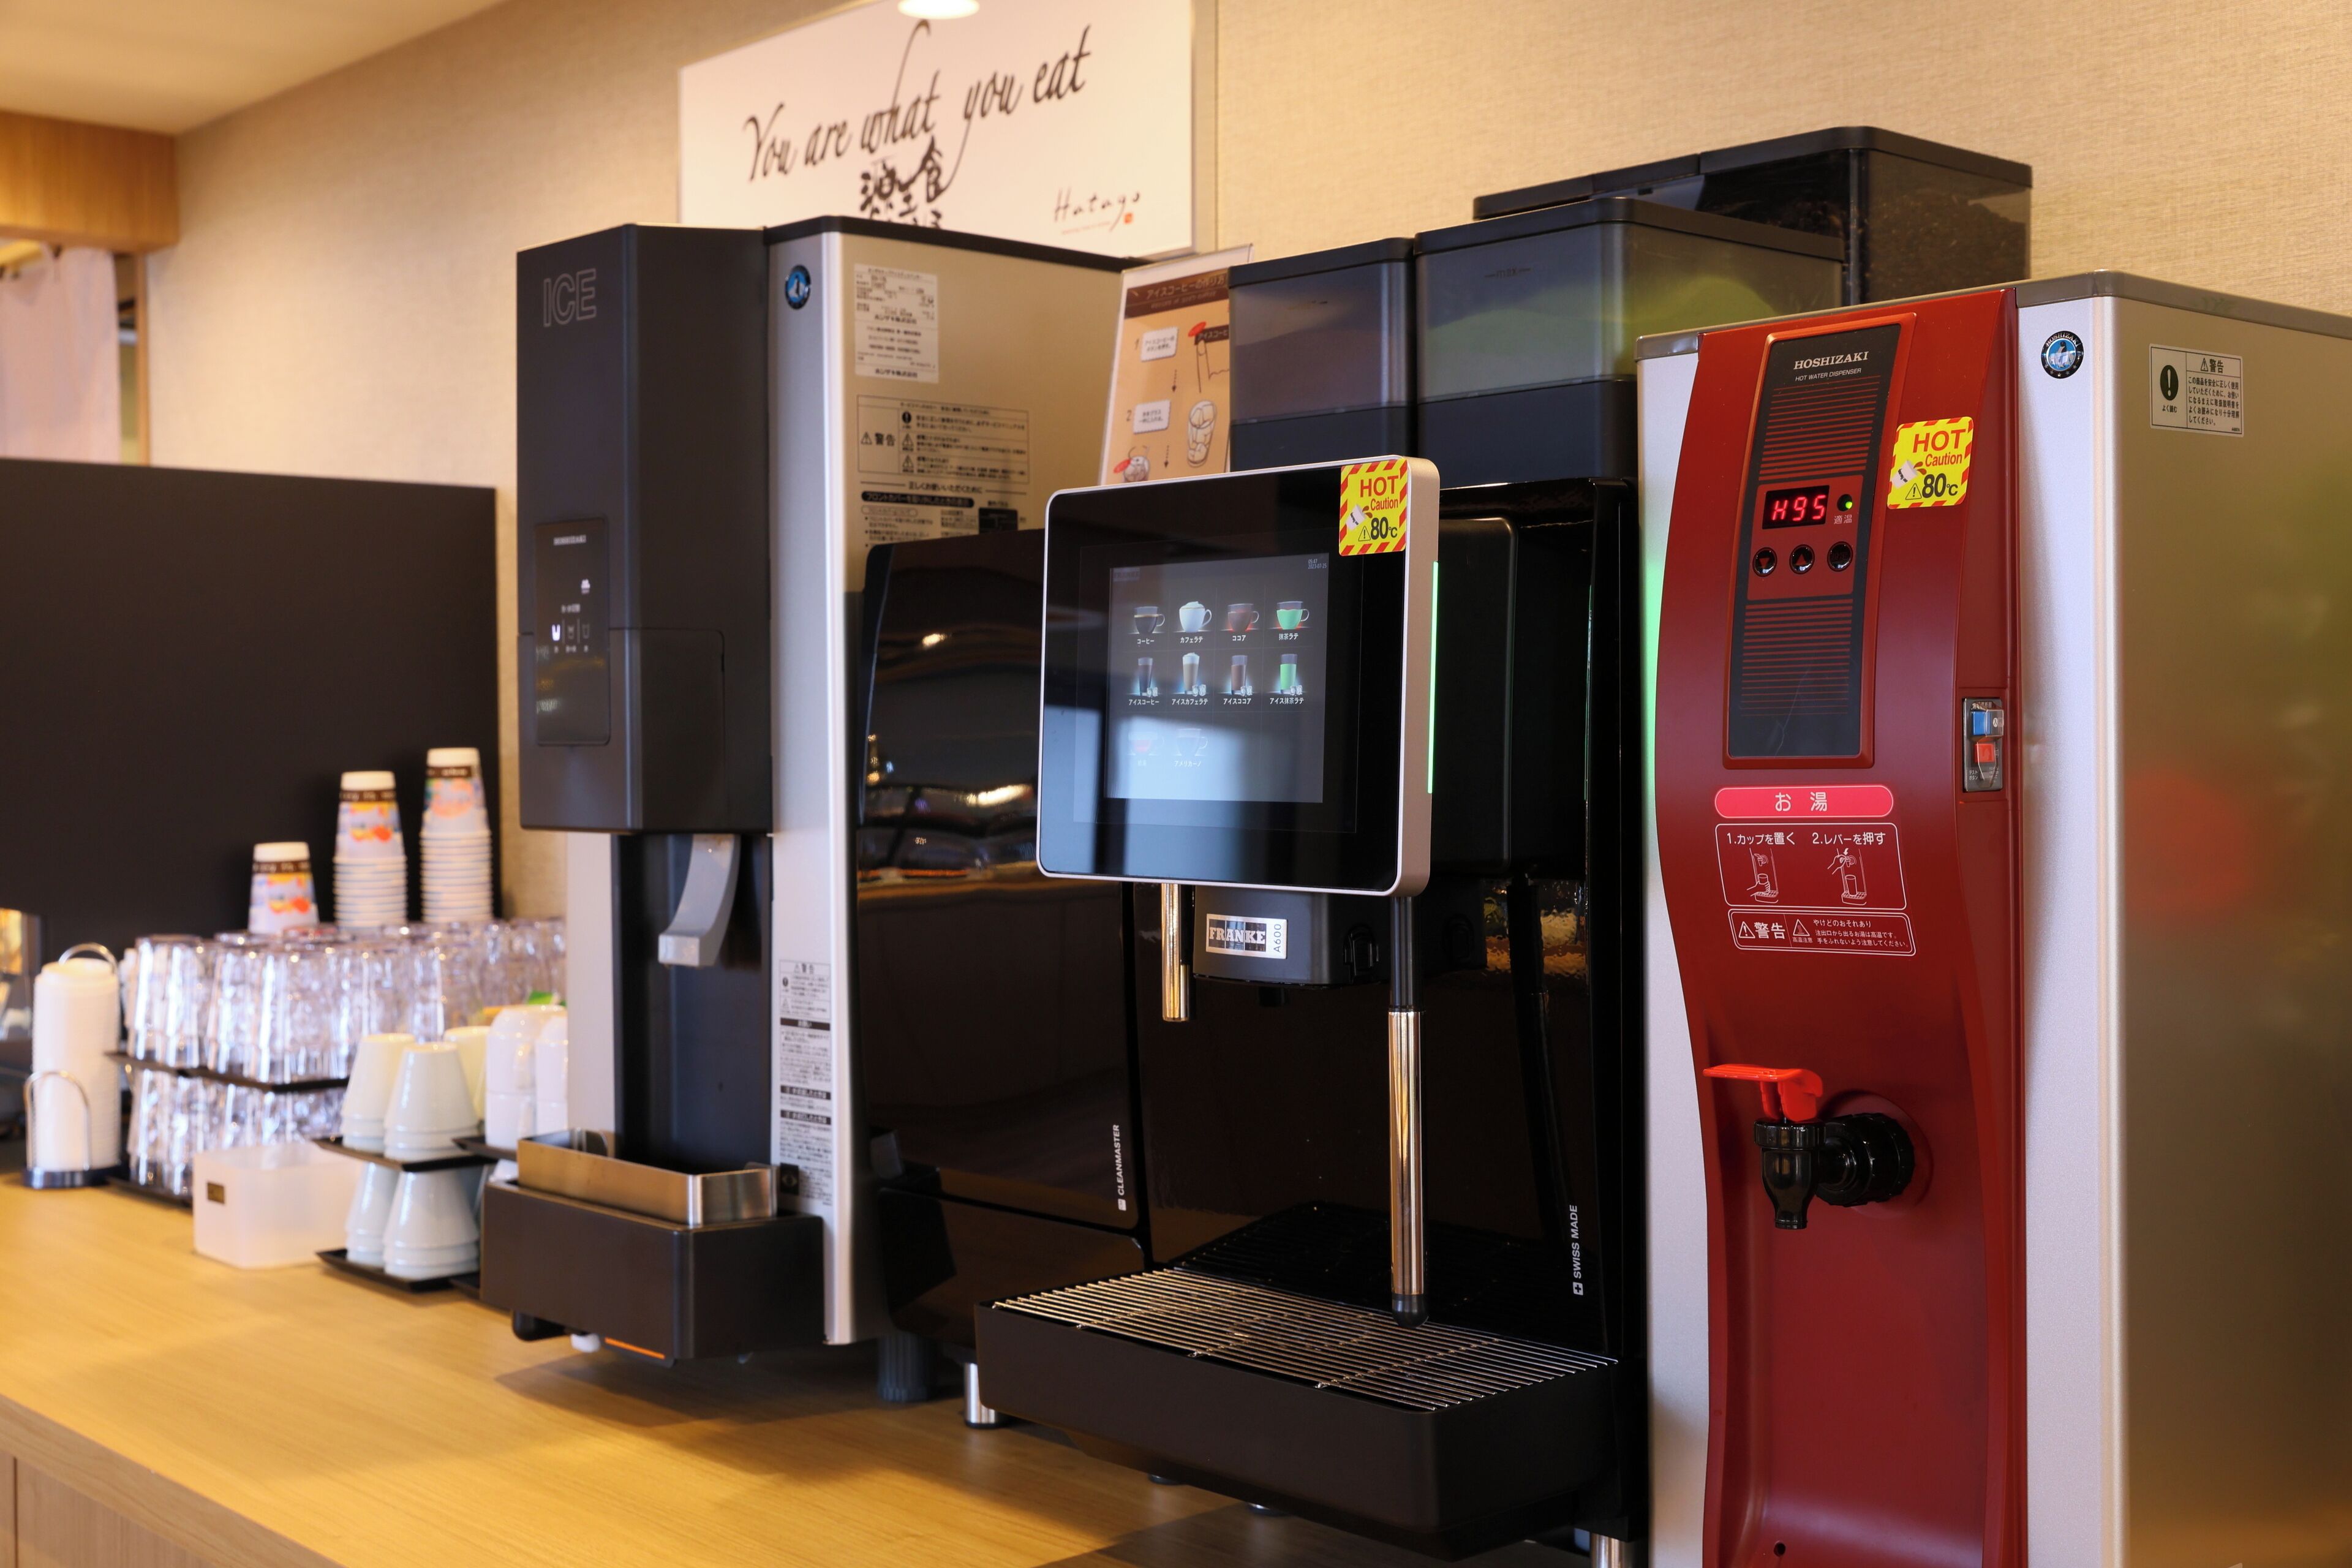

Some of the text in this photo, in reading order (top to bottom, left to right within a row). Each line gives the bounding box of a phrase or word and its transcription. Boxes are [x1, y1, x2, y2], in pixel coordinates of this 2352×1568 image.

[743, 102, 797, 181] You
[804, 120, 853, 165] are
[861, 19, 940, 154] what
[1033, 23, 1091, 103] eat
[1054, 186, 1142, 233] Hatago
[543, 268, 597, 327] ICE
[2046, 333, 2081, 347] HOSHIZAKI
[1793, 351, 1869, 370] HOSHIZAKI
[2209, 359, 2223, 374] 警告
[1829, 368, 1861, 377] DISPENSER
[2162, 404, 2177, 413] よく読む
[2189, 415, 2216, 426] してください。
[1913, 429, 1966, 453] HOT
[1925, 452, 1962, 467] Caution
[1360, 475, 1398, 497] HOT
[1371, 498, 1398, 511] Caution
[1771, 494, 1826, 521] H95
[1834, 514, 1852, 524] 適温
[1775, 791, 1828, 812] お湯
[1727, 832, 1886, 845] 1.カップを置く 2.レバーを押す
[1754, 922, 1785, 939] 警告
[1813, 919, 1871, 927] やけどのおそれあり
[1209, 927, 1266, 944] FRANKE
[1273, 924, 1282, 952] A600
[1815, 929, 1897, 939] 注出口から出るお湯は高温です。
[1817, 938, 1909, 948] 手をふれないよう注意してください。
[1113, 1125, 1125, 1196] CLEANMASTER
[1569, 1204, 1581, 1279] SWISS MADE
